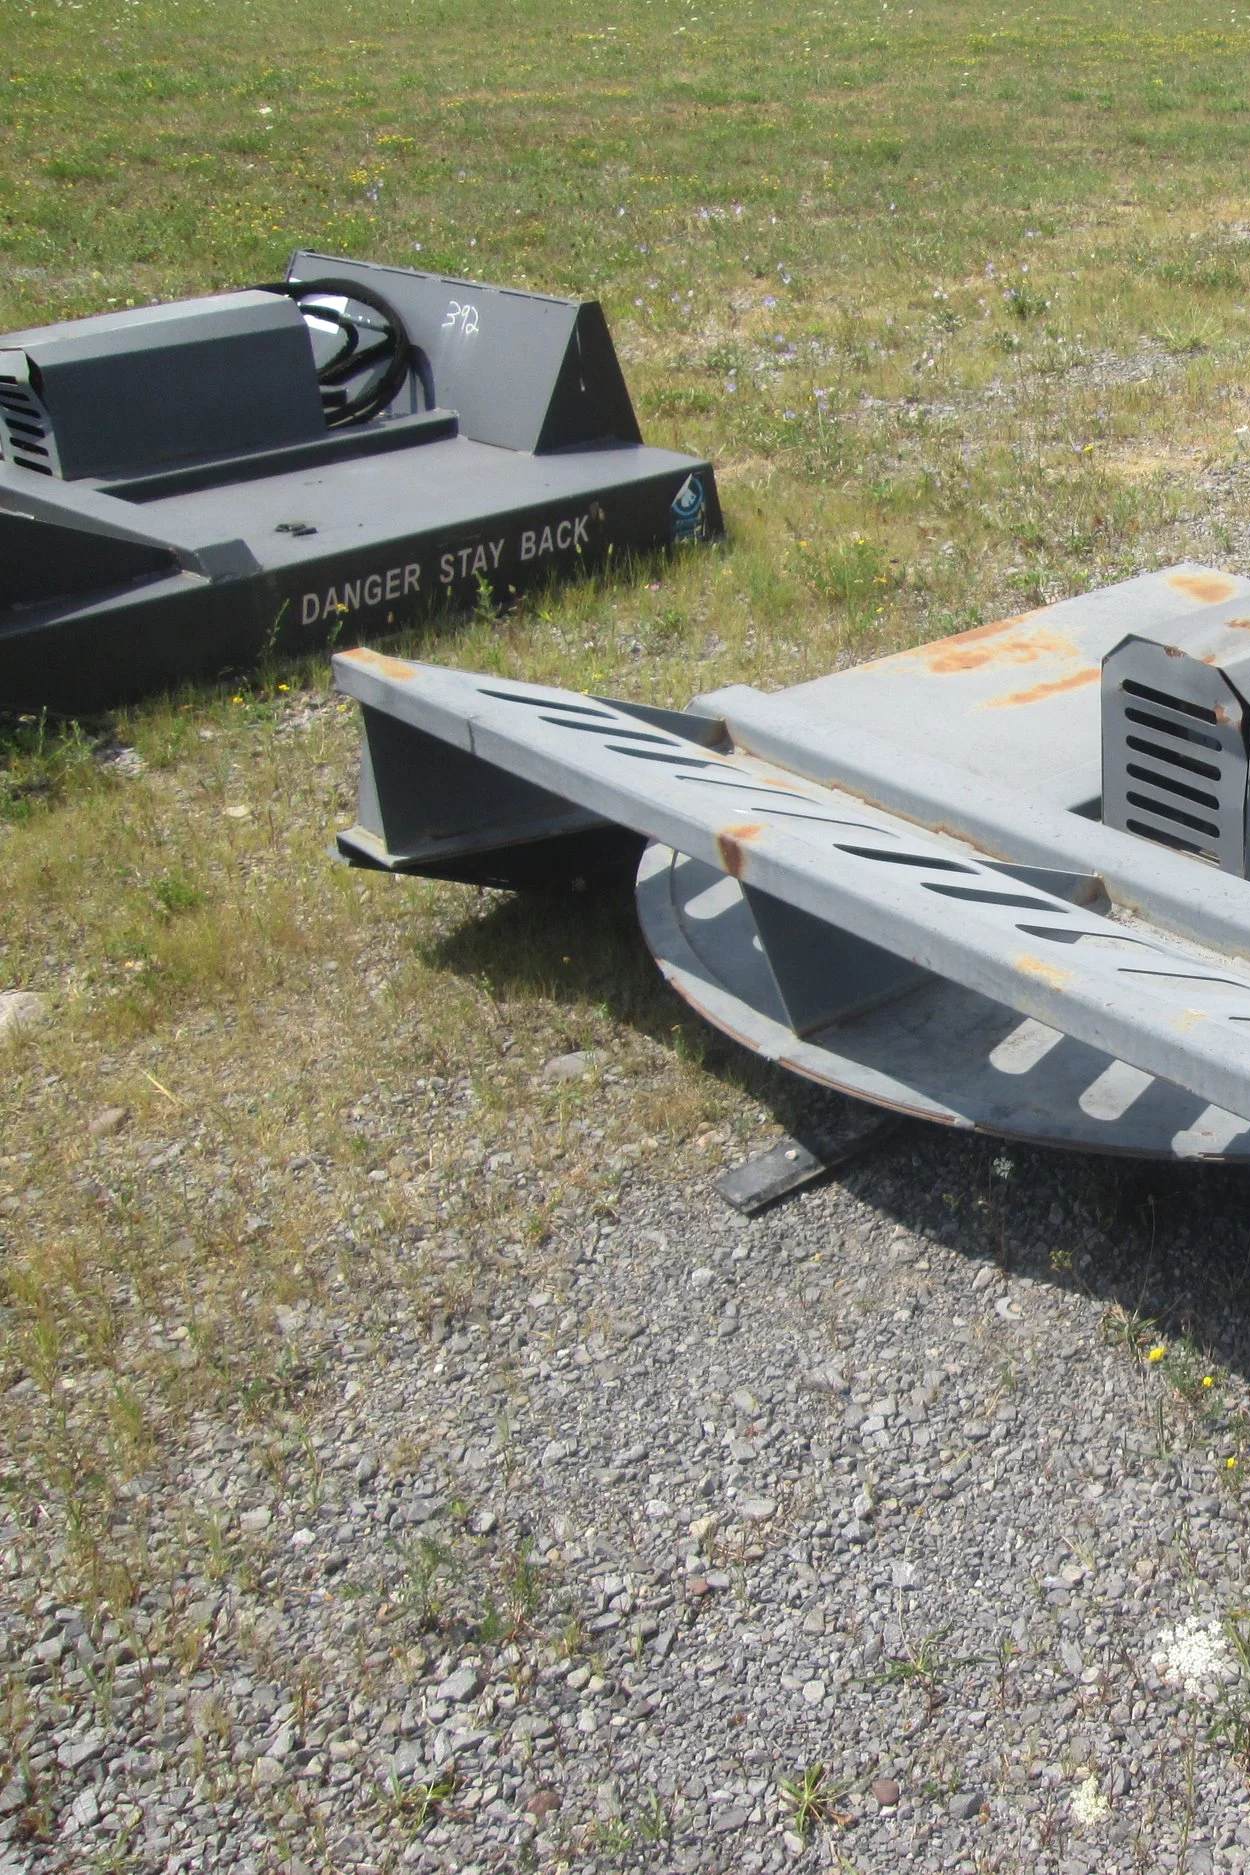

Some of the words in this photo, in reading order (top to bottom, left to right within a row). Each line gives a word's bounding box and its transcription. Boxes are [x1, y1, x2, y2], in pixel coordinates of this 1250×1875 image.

[441, 300, 480, 334] 392
[301, 563, 421, 625] DANGER
[439, 538, 505, 584] STAY
[520, 514, 589, 561] BACK
